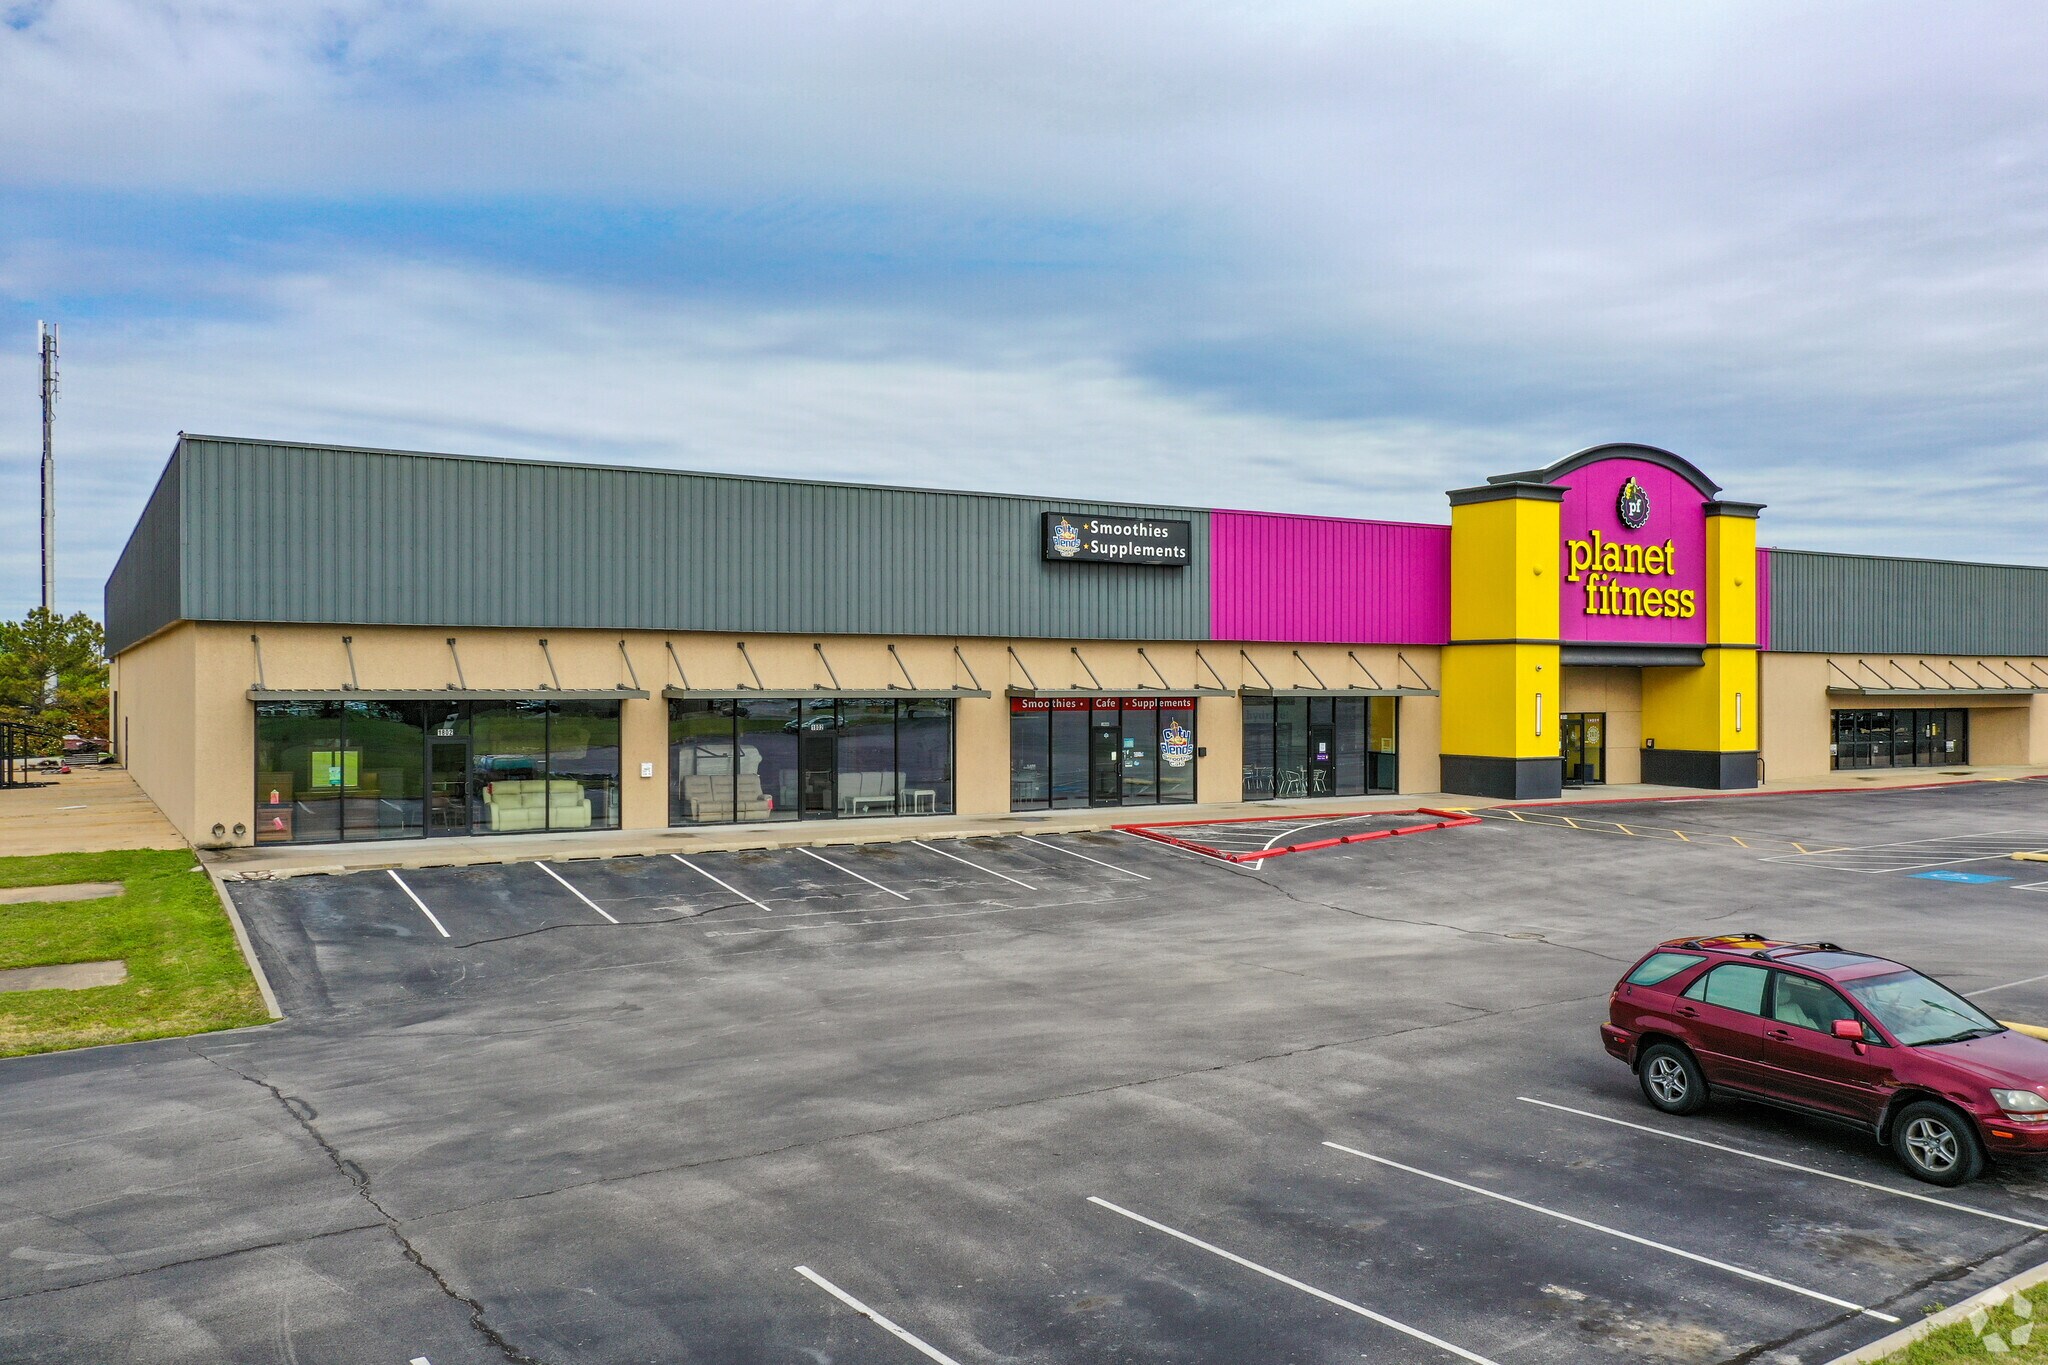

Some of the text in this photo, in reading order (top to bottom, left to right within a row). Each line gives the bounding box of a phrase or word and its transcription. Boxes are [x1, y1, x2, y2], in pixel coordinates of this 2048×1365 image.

[1628, 499, 1642, 517] pf
[1090, 520, 1169, 538] Smoothies
[1090, 540, 1186, 559] Supplements
[1567, 530, 1676, 582] planet
[1586, 573, 1696, 618] fitness
[1022, 698, 1191, 710] Smoothies Cafe Supplements
